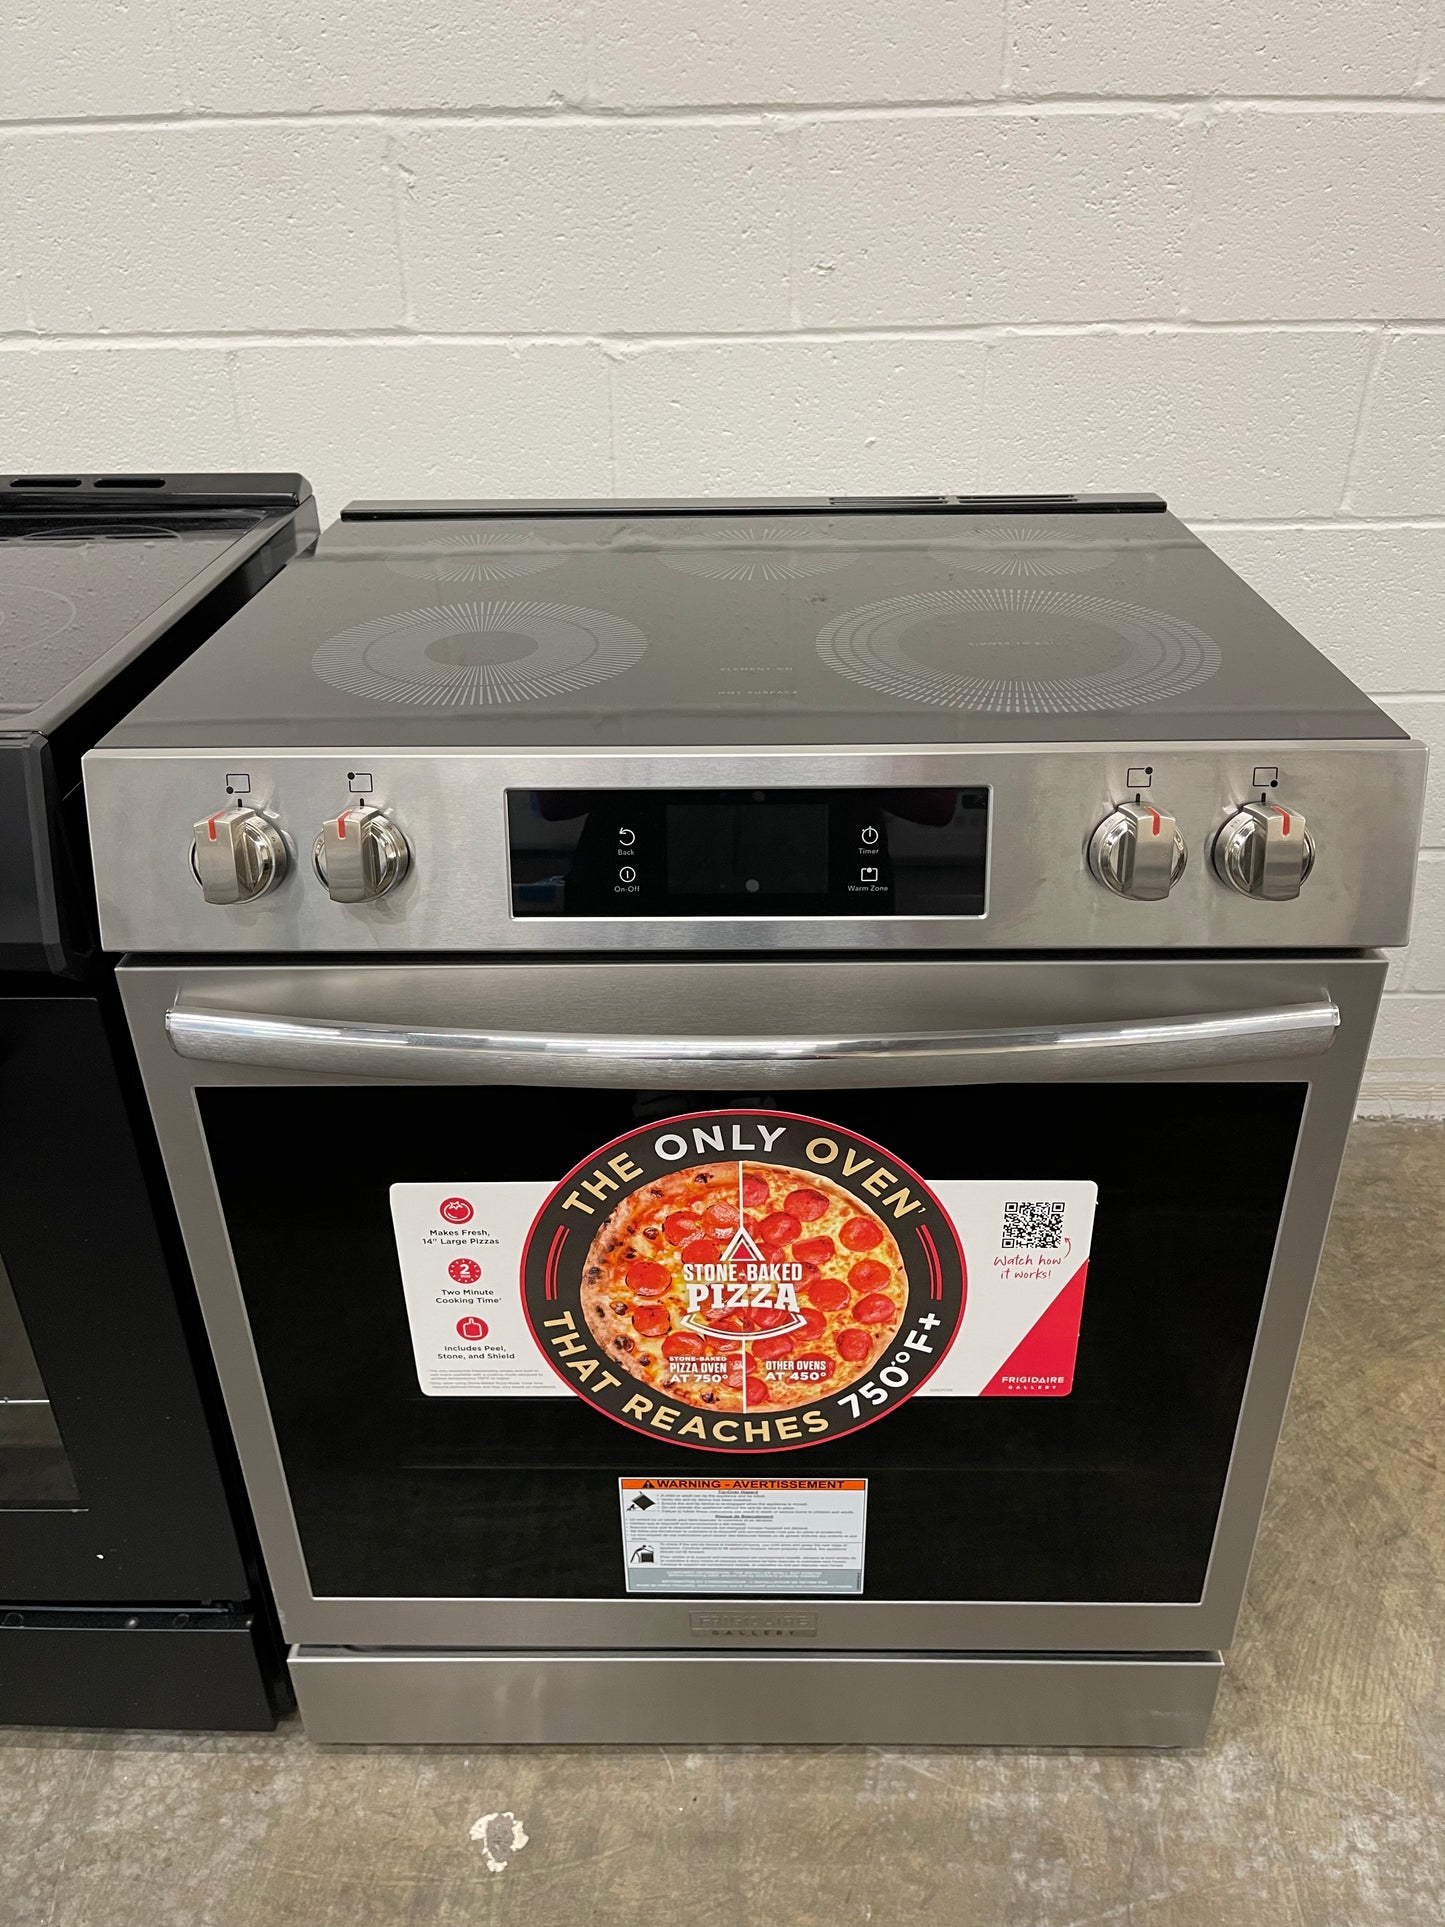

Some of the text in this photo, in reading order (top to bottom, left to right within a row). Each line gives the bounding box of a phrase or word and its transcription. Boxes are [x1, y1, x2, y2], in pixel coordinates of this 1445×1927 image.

[617, 848, 635, 856] Back
[858, 847, 879, 855] Timer
[847, 884, 889, 892] Warm Zone
[561, 1151, 643, 1217] THE
[654, 1124, 787, 1162] ONLY
[461, 1229, 491, 1237] Fresh,
[440, 1238, 468, 1246] Large
[993, 1254, 1062, 1267] Watch how
[460, 1263, 470, 1275] 2
[683, 1263, 803, 1282] STONE-BAKED
[1000, 1269, 1052, 1280] it works!
[435, 1297, 474, 1305] Cooking
[686, 1283, 800, 1314] PIZZA
[484, 1345, 507, 1353] Peel,
[669, 1362, 727, 1373] PIZZA OVEN
[765, 1360, 827, 1371] OTHER OVENS
[543, 1310, 622, 1393] THAT
[621, 1393, 829, 1443] REACHES
[670, 1374, 728, 1383] AT 750°
[765, 1372, 827, 1381] AT 450°
[1001, 1376, 1065, 1384] FRIGIDAIRE
[656, 1480, 721, 1488] WARNING
[732, 1480, 845, 1489] AVERTISSEMENT
